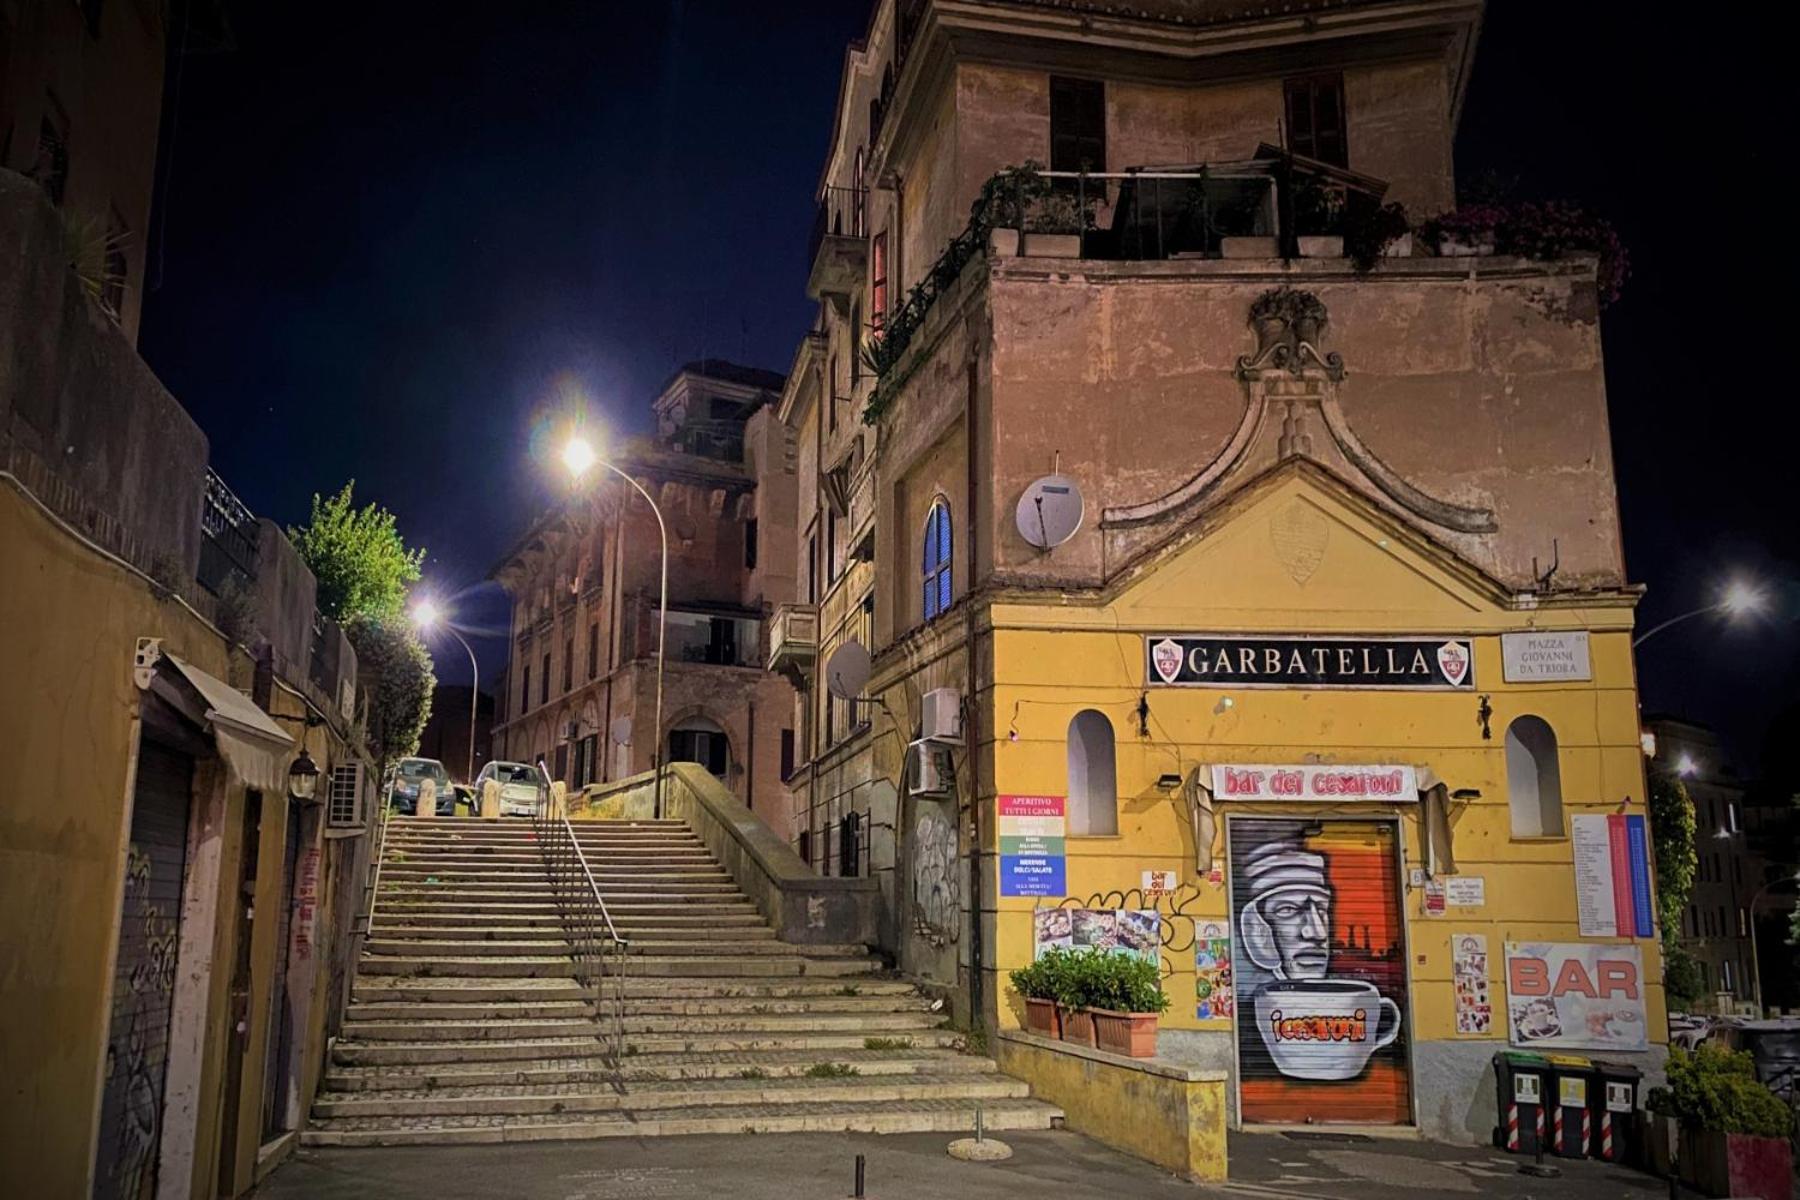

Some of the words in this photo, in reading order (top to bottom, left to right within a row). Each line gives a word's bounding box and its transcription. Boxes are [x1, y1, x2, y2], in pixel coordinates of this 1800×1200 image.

[1528, 639, 1565, 649] PIAZZA
[1188, 647, 1430, 674] GARBATELLA
[1521, 651, 1573, 662] GIOVANNI
[1520, 665, 1533, 674] DA
[1224, 767, 1265, 795] bar
[1269, 769, 1304, 796] dei
[1012, 797, 1052, 806] APERITIVO
[1005, 807, 1027, 816] TUTTI
[1031, 807, 1059, 816] GIORNI
[1508, 957, 1639, 1001] BAR
